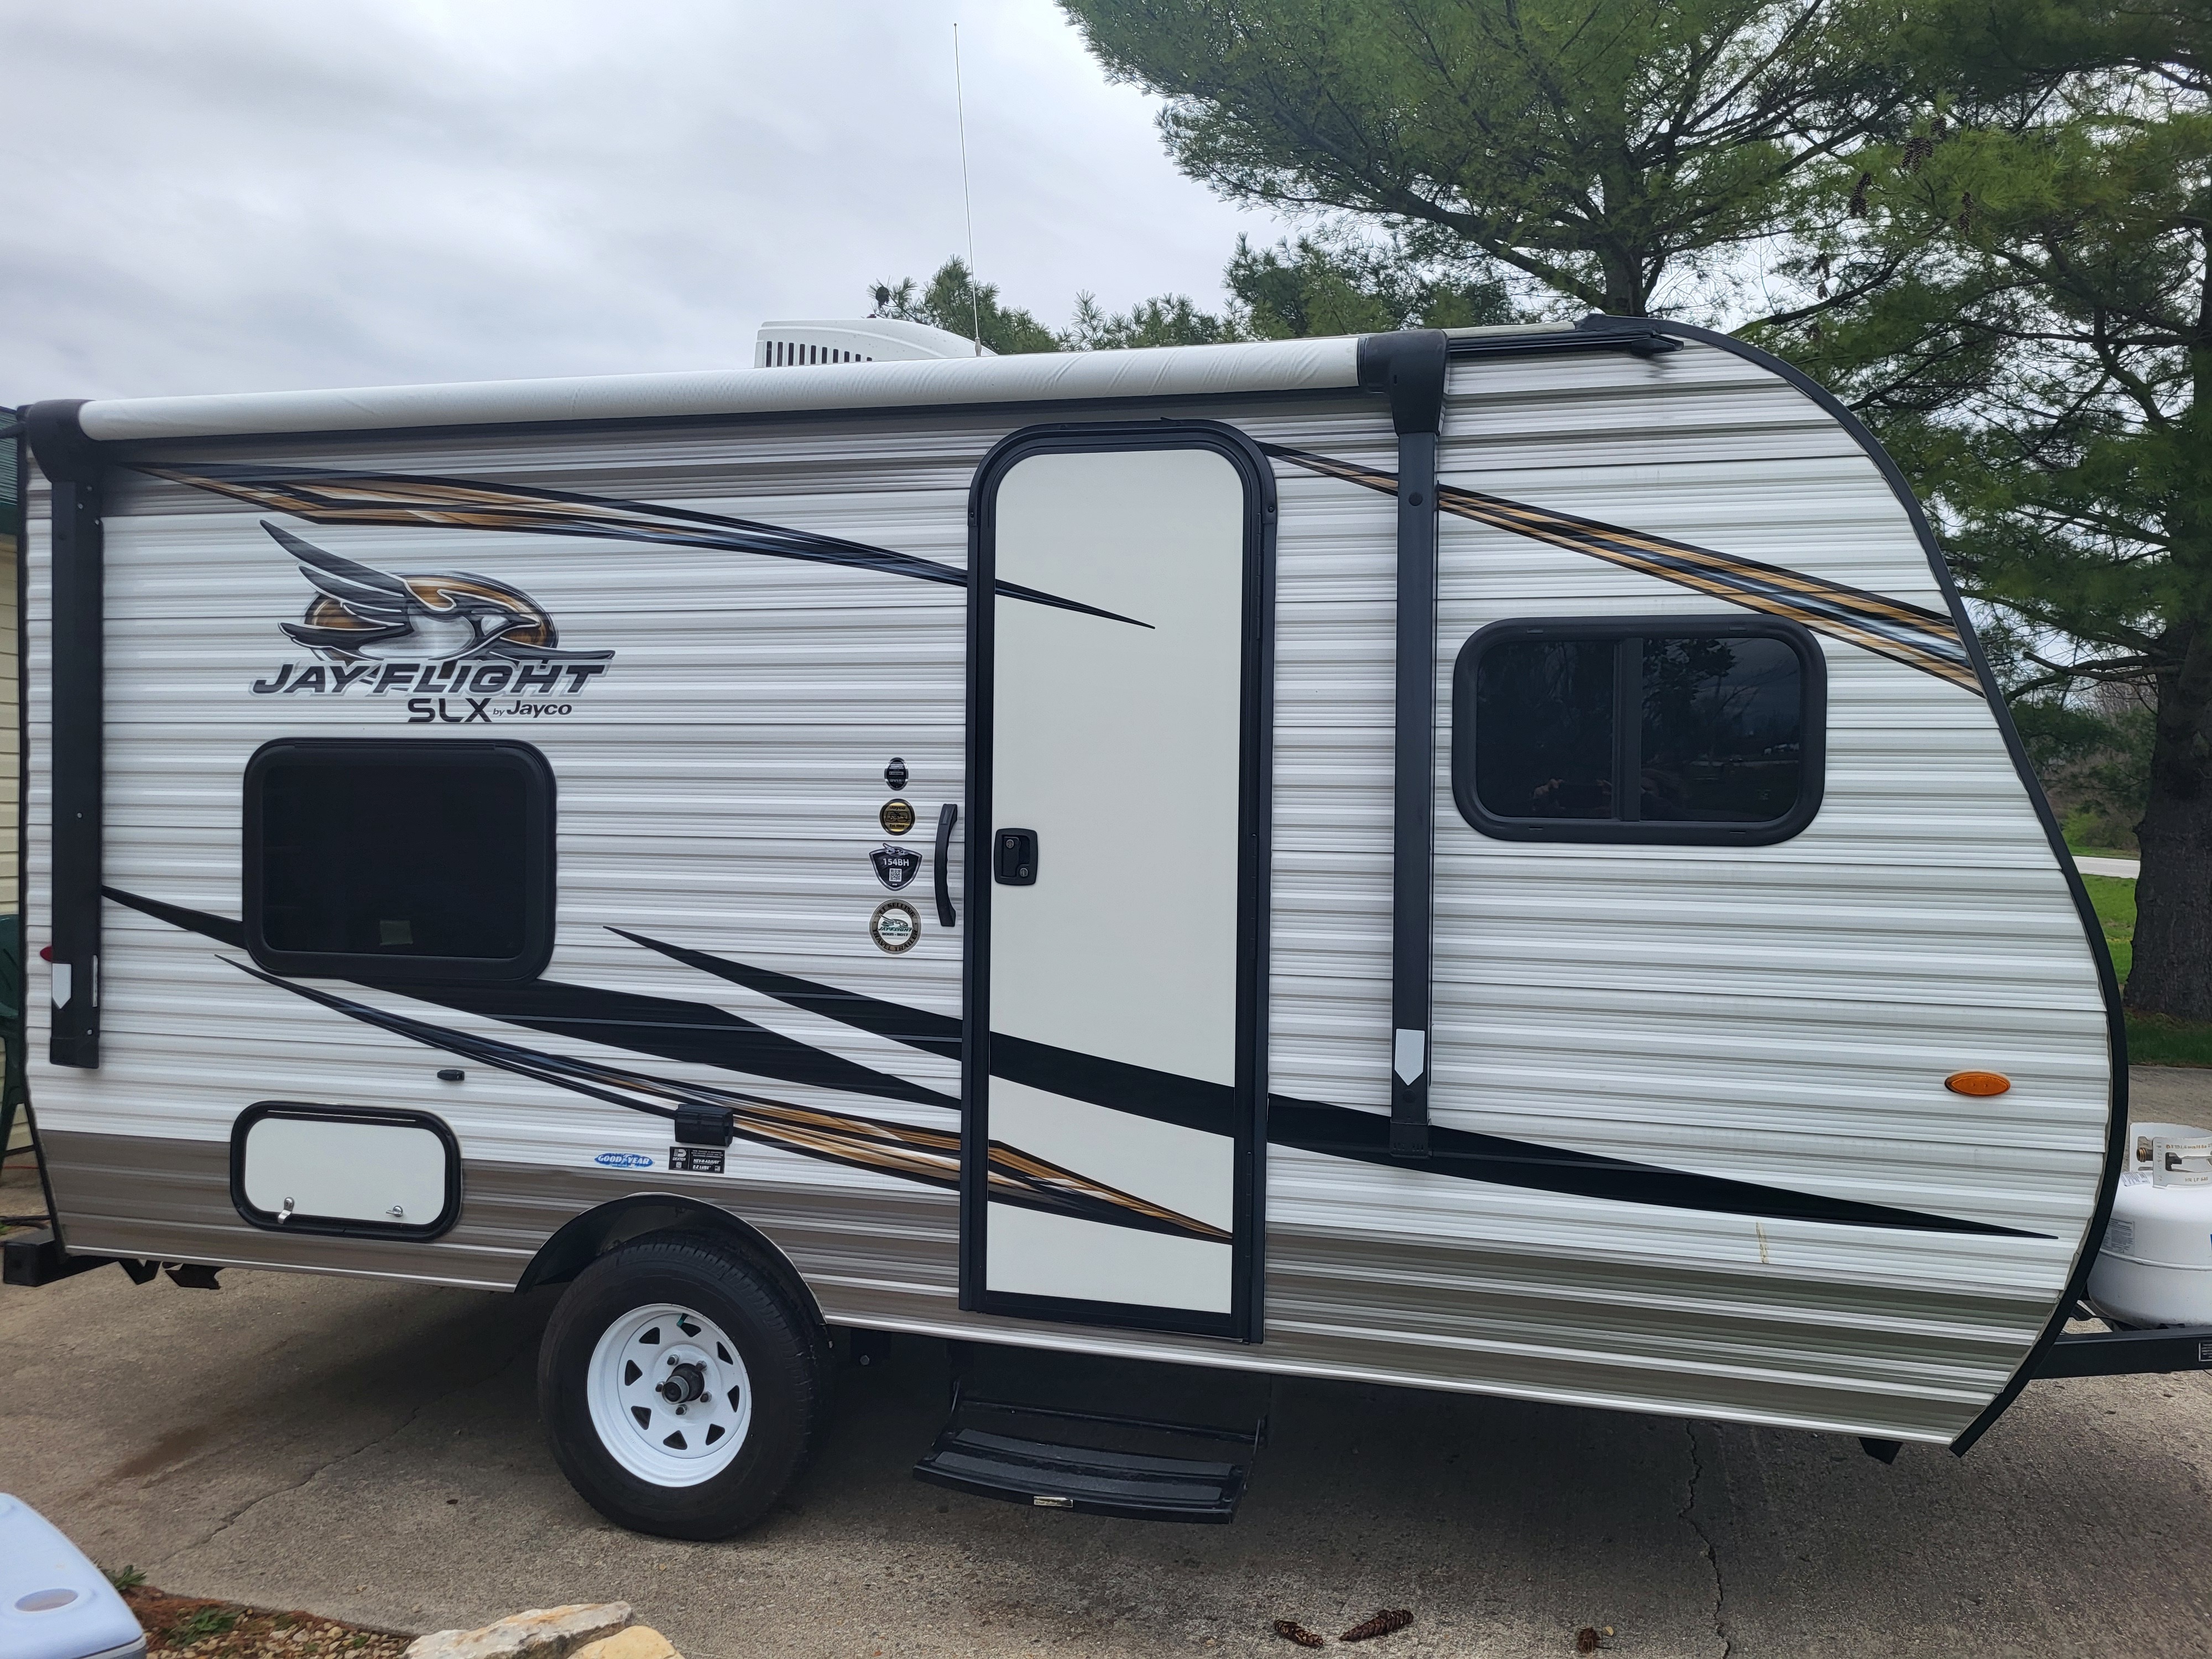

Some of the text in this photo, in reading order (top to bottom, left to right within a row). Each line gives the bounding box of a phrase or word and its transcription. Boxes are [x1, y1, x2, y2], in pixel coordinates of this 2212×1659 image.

[253, 664, 605, 693] JAY FLIGHT
[408, 698, 572, 723] SLX by Jayco
[888, 902, 916, 917] SELLING
[873, 930, 918, 951] TRAVEL TRAILER
